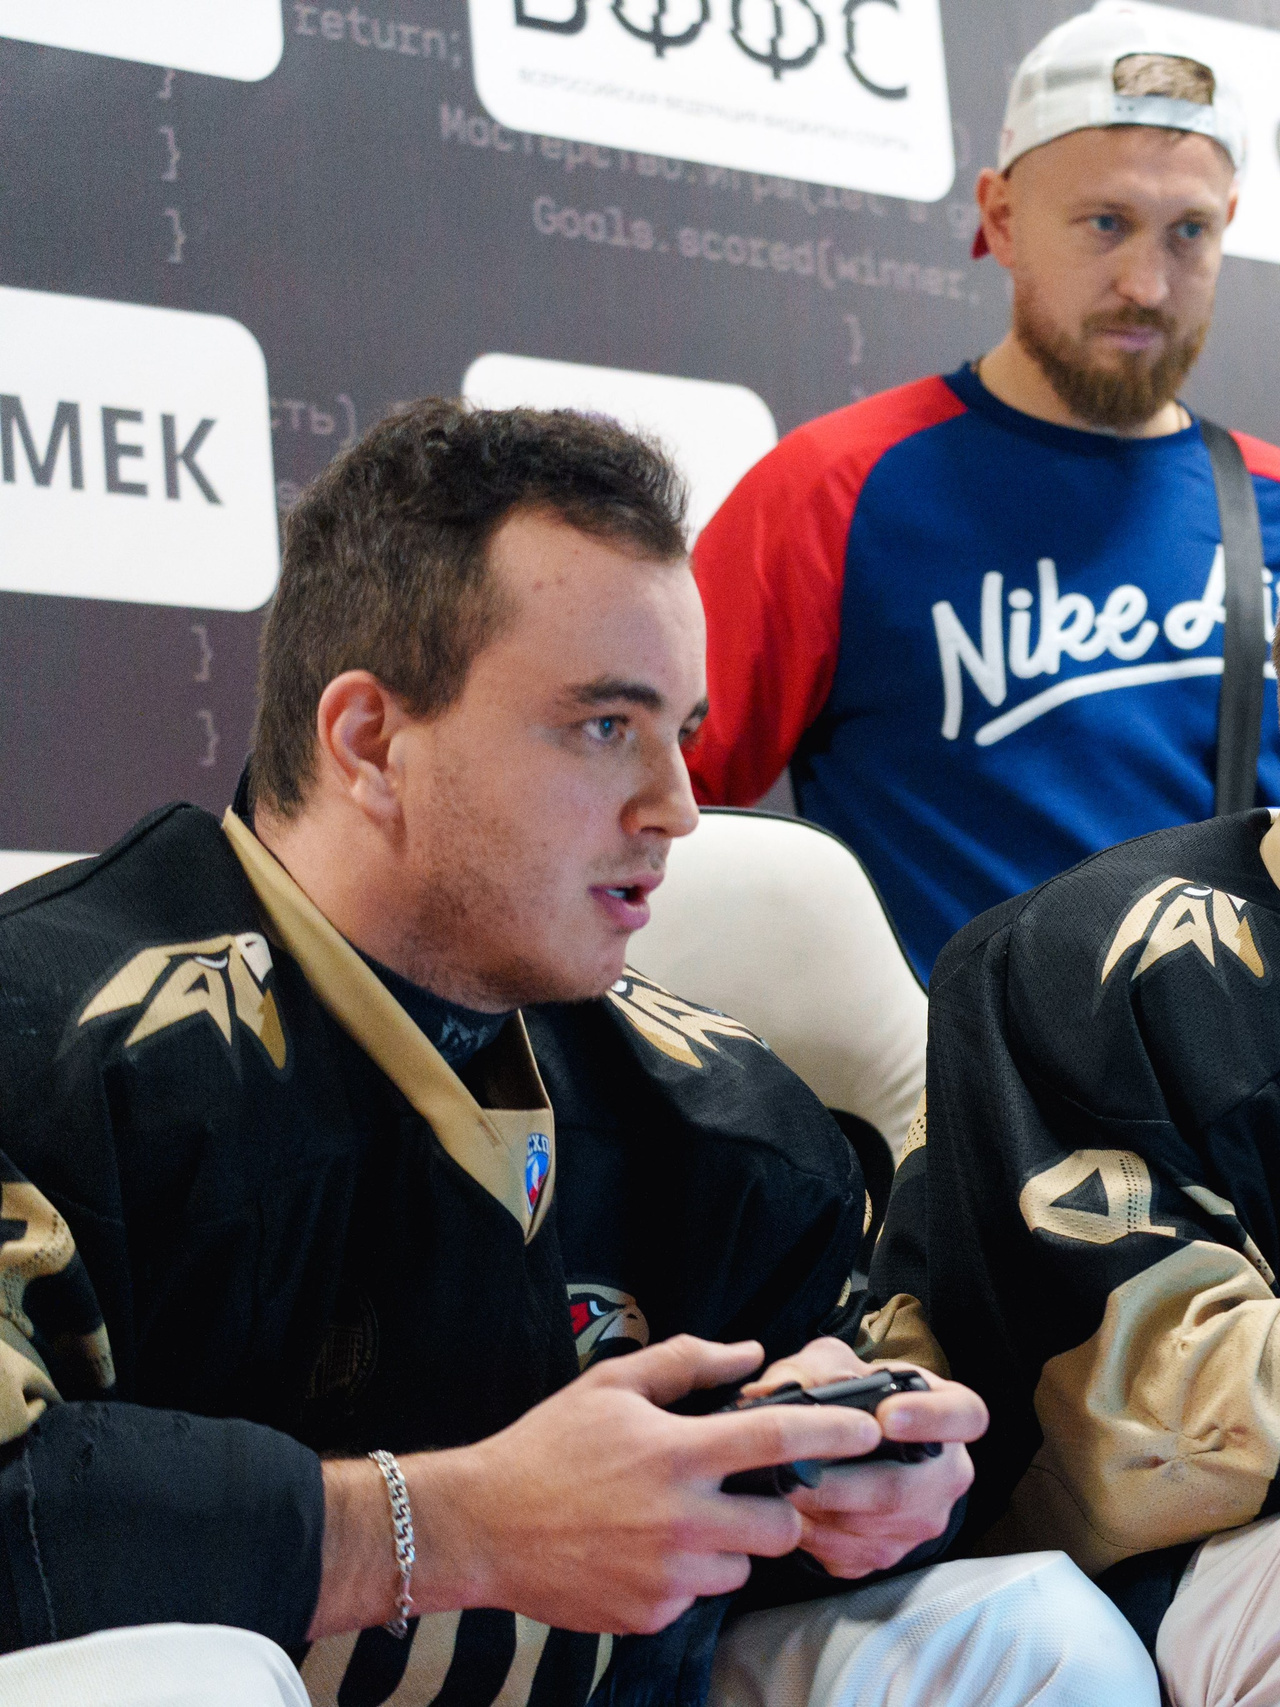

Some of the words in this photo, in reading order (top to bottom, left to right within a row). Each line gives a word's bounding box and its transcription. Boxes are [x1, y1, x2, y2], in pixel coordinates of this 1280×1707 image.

[294, 3, 461, 69] return;
[514, 0, 909, 101] ФС
[0, 394, 224, 506] МЕК
[931, 557, 1159, 740] Nike
